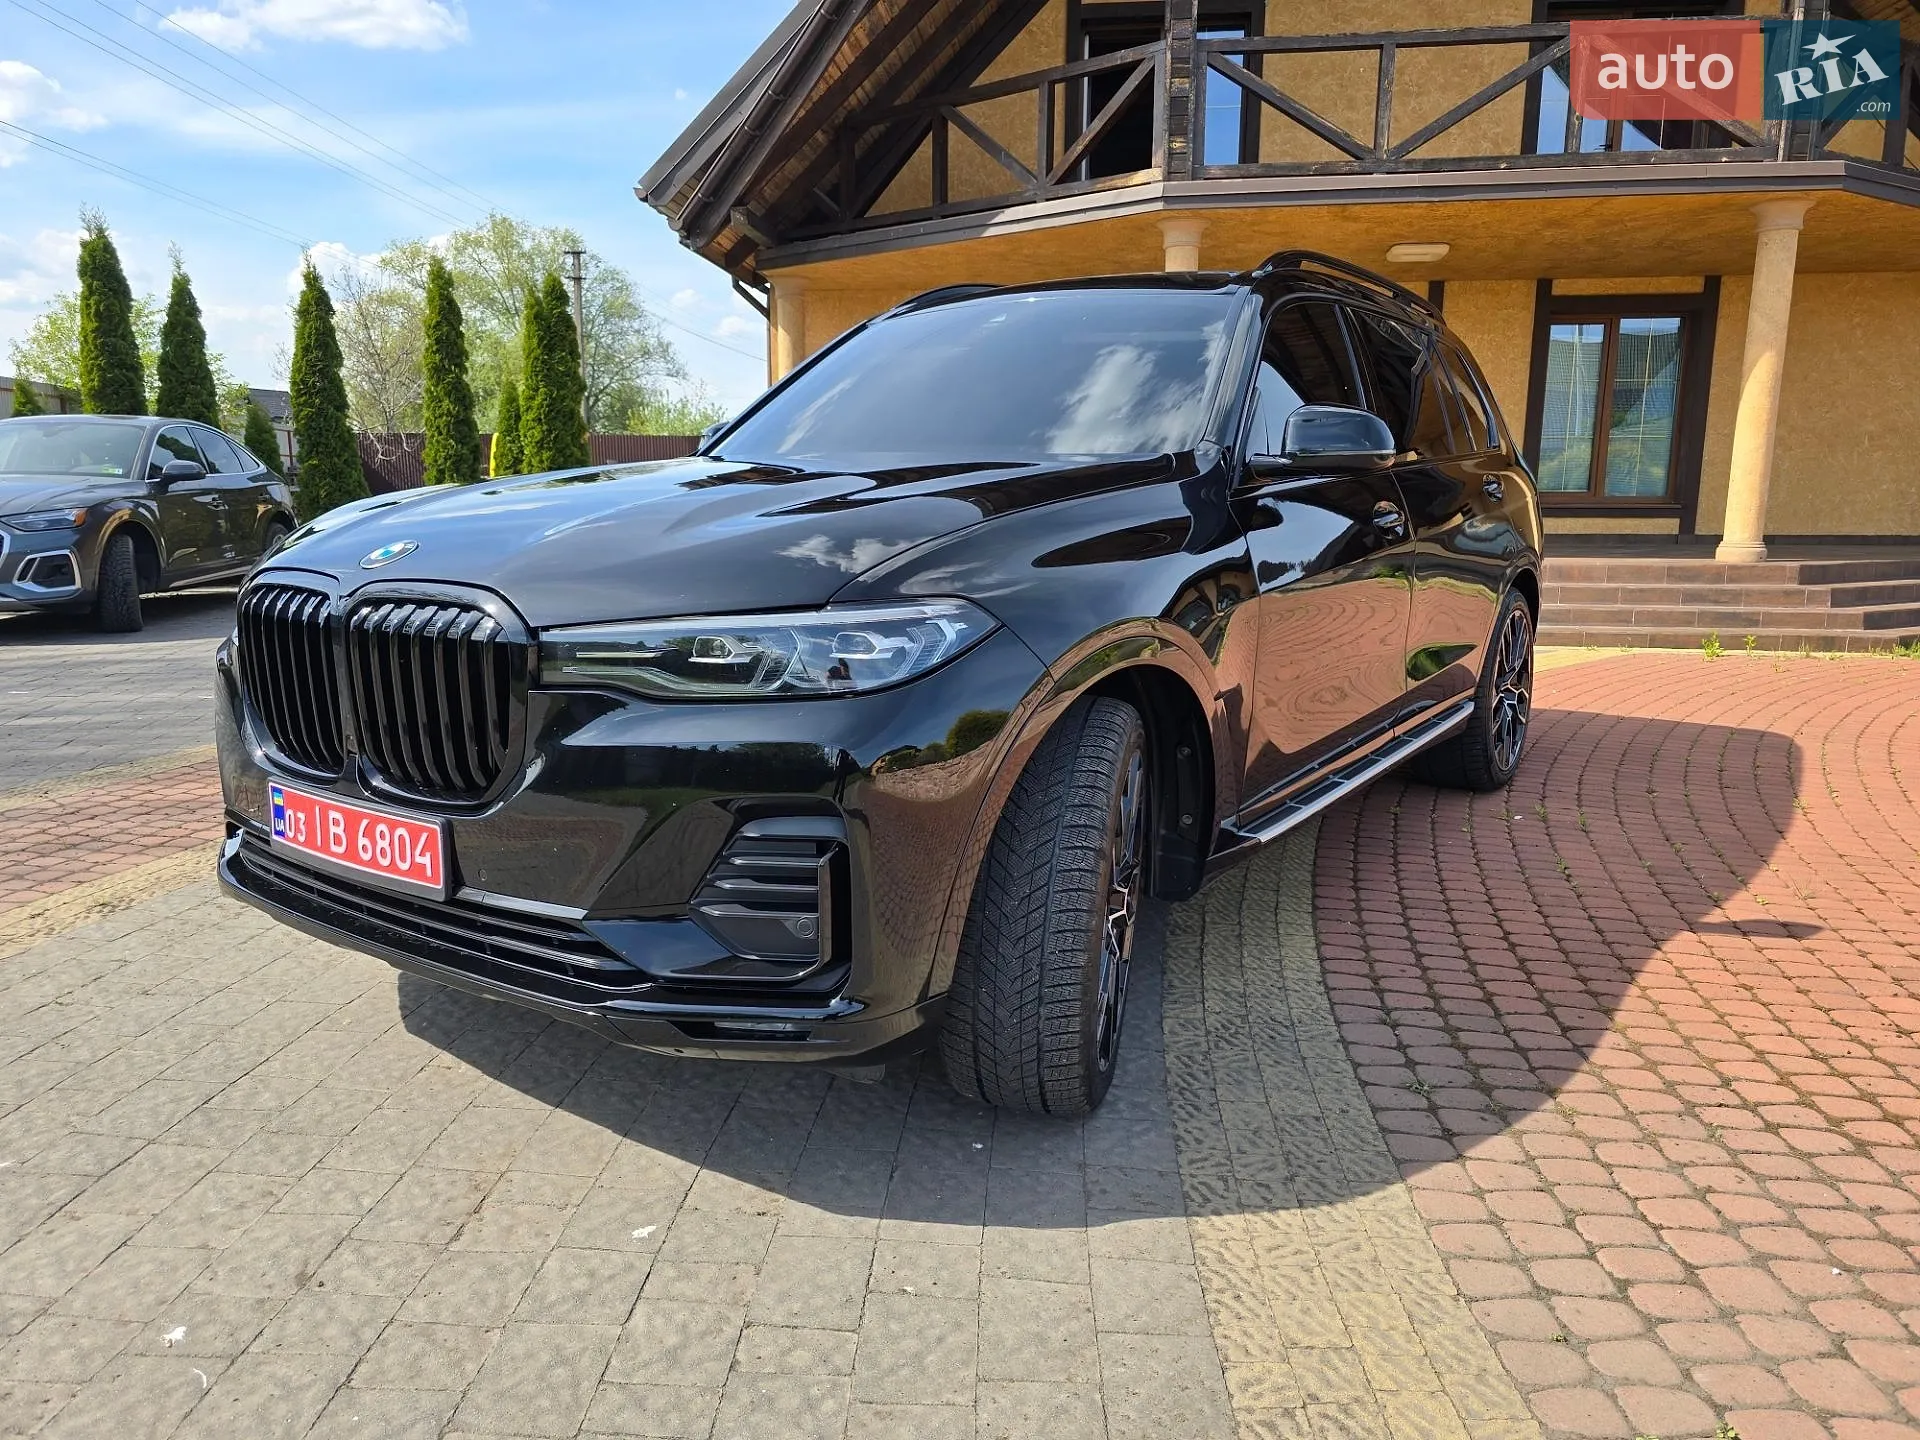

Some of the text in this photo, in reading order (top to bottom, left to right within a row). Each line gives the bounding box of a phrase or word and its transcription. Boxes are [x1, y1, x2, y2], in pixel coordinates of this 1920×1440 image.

[275, 817, 285, 832] UA
[285, 805, 433, 878] 03 IB 6804
